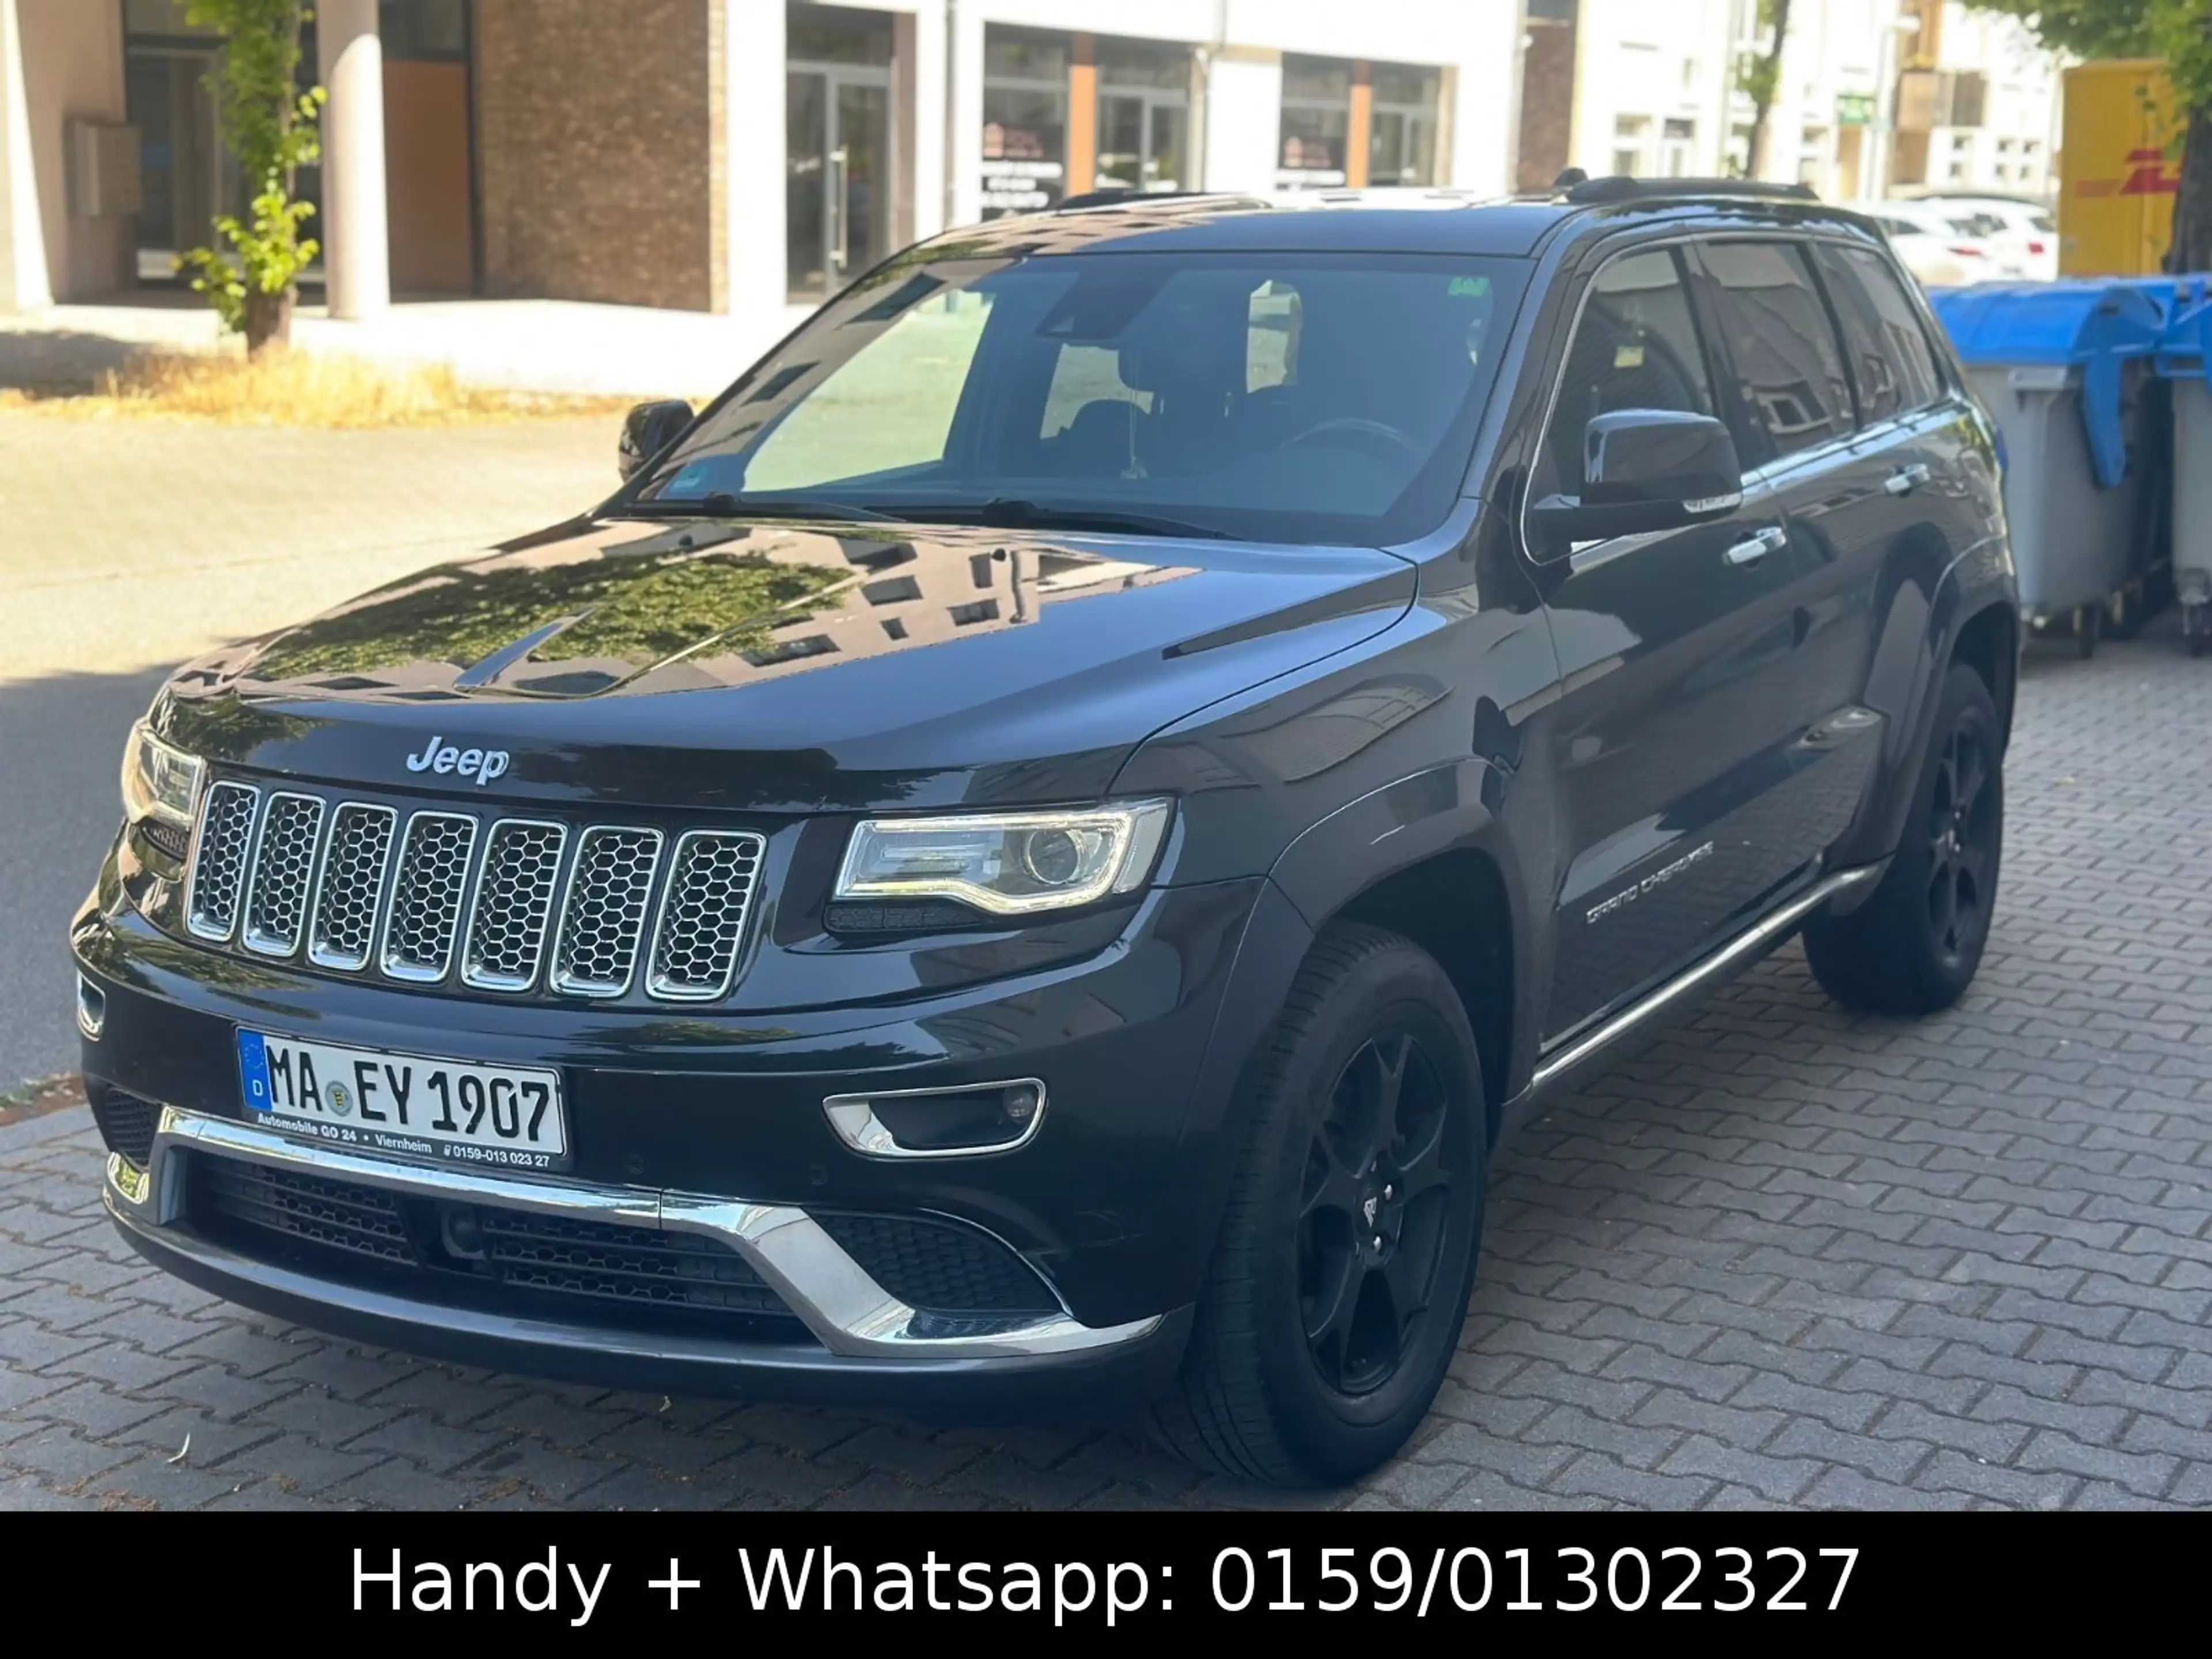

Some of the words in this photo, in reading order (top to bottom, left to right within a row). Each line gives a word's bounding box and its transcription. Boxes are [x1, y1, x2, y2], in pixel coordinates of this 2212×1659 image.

[406, 735, 510, 786] Jeep
[253, 1079, 263, 1096] D
[266, 1045, 323, 1111] MA
[354, 1060, 411, 1124] EY
[427, 1071, 549, 1141] 1907
[257, 1112, 318, 1135] Automobile
[320, 1126, 339, 1139] GO
[342, 1130, 357, 1142] 24
[375, 1134, 432, 1153] Viernheim
[453, 1146, 507, 1162] 0159-013
[510, 1152, 532, 1165] 023
[535, 1156, 550, 1167] 27
